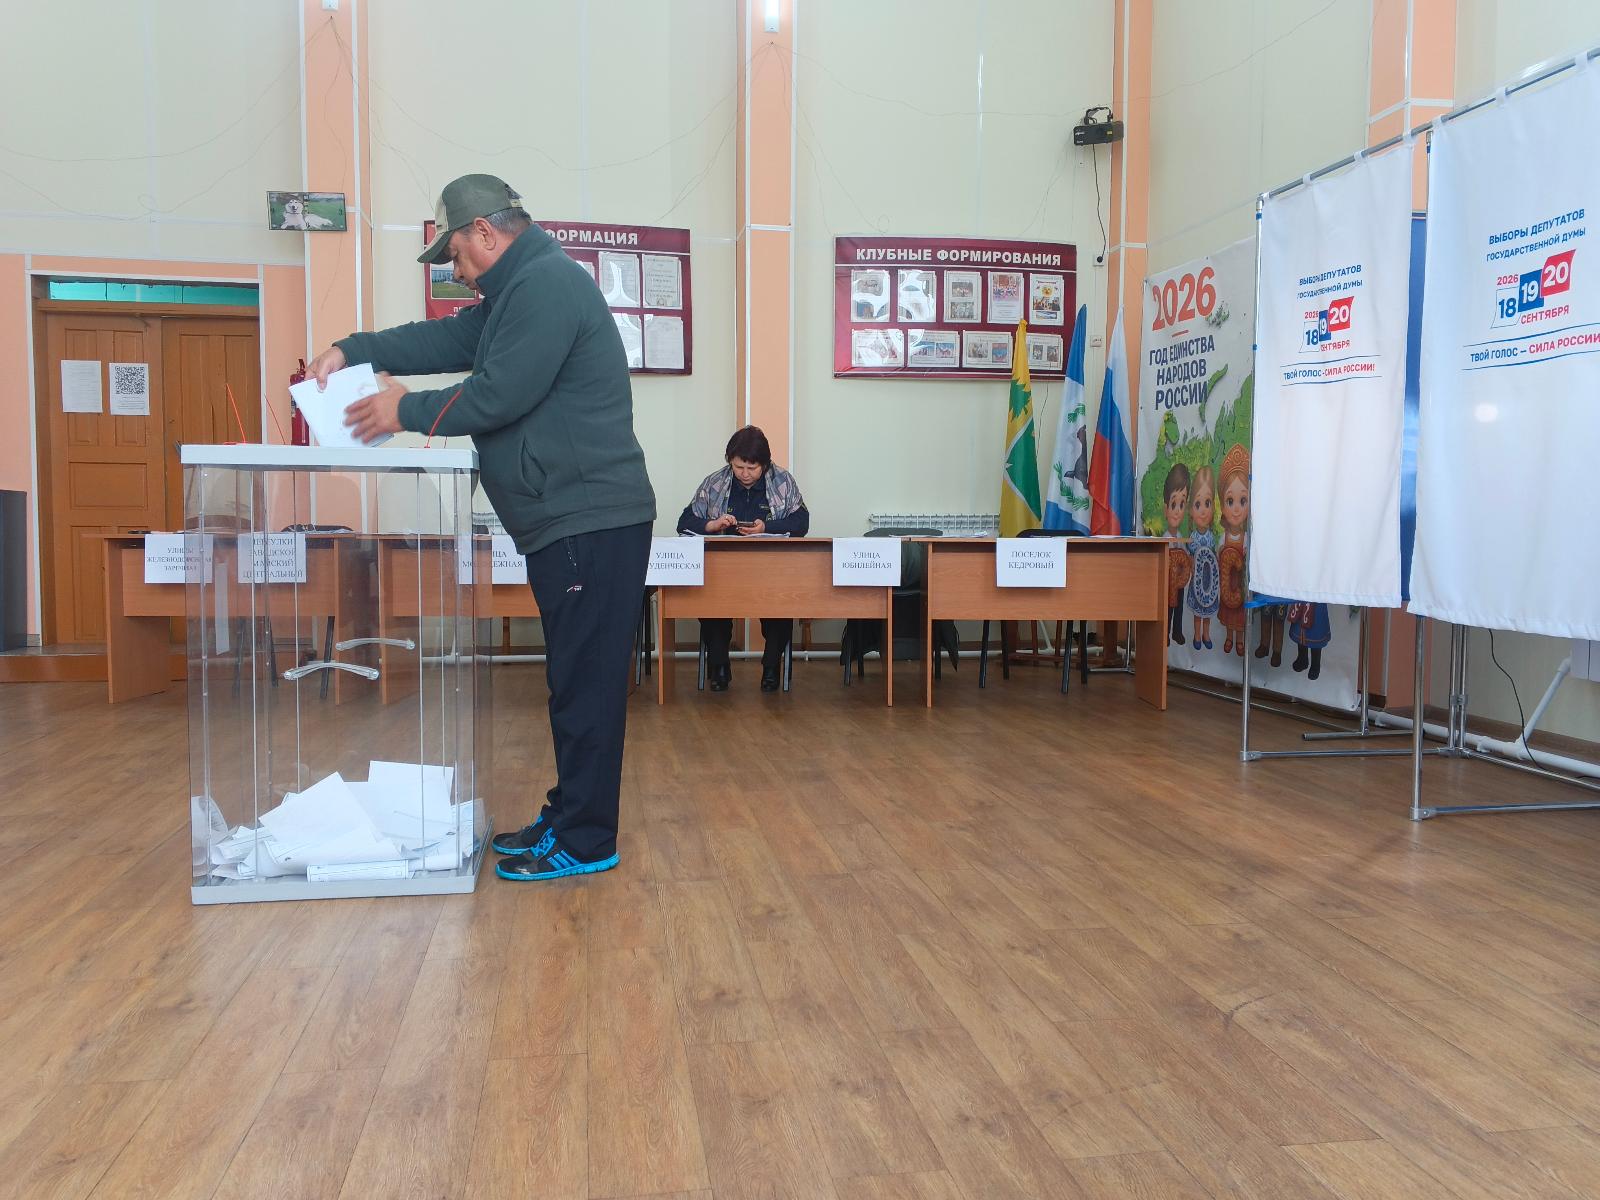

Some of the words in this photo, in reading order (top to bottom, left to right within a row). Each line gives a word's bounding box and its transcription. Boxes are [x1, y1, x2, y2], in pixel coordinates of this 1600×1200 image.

[1489, 227, 1528, 245] ВЫБОРЫ
[1531, 208, 1585, 236] ДЕПУТАТОВ
[545, 229, 638, 246] ФОРМАЦИЯ
[1486, 233, 1560, 262] ГОСУДАРСТВЕННОЙ
[1562, 227, 1586, 243] ДУМЫ
[856, 248, 932, 261] КЛУБНЫЕ
[936, 249, 1061, 266] ФОРМИРОВАНИЯ
[1343, 279, 1363, 291] ДУМЫ
[1497, 274, 1519, 286] 2026
[1152, 266, 1217, 331] 2026
[1498, 297, 1517, 319] 18
[1521, 280, 1539, 304] 19
[1543, 261, 1569, 288] 20
[1520, 304, 1570, 325] СЕНТЯБРЯ
[1305, 329, 1319, 346] 18
[1329, 304, 1350, 325] 20
[1150, 348, 1169, 366] ГОД
[1169, 335, 1215, 363] ЕДИНСТВА
[1470, 349, 1490, 362] ТВОЙ
[1491, 347, 1518, 360] ГОЛОС
[1529, 340, 1556, 354] СИЛА
[1156, 358, 1207, 386] НАРОДОВ
[1283, 369, 1298, 381] ТВОЙ
[1299, 369, 1322, 378] ГОЛОС
[1325, 367, 1342, 377] СИЛА
[1343, 363, 1376, 373] РОССИИ!
[1155, 380, 1209, 411] РОССИИ
[853, 551, 881, 560] УЛИЦА
[1011, 550, 1052, 559] ПОСЕЛОК
[649, 562, 701, 570] УДЕНЧЕСКАЯ
[842, 560, 892, 570] ЮБИЛЕЙНАЯ
[1008, 560, 1054, 570] КЕДРОВЫЙ
